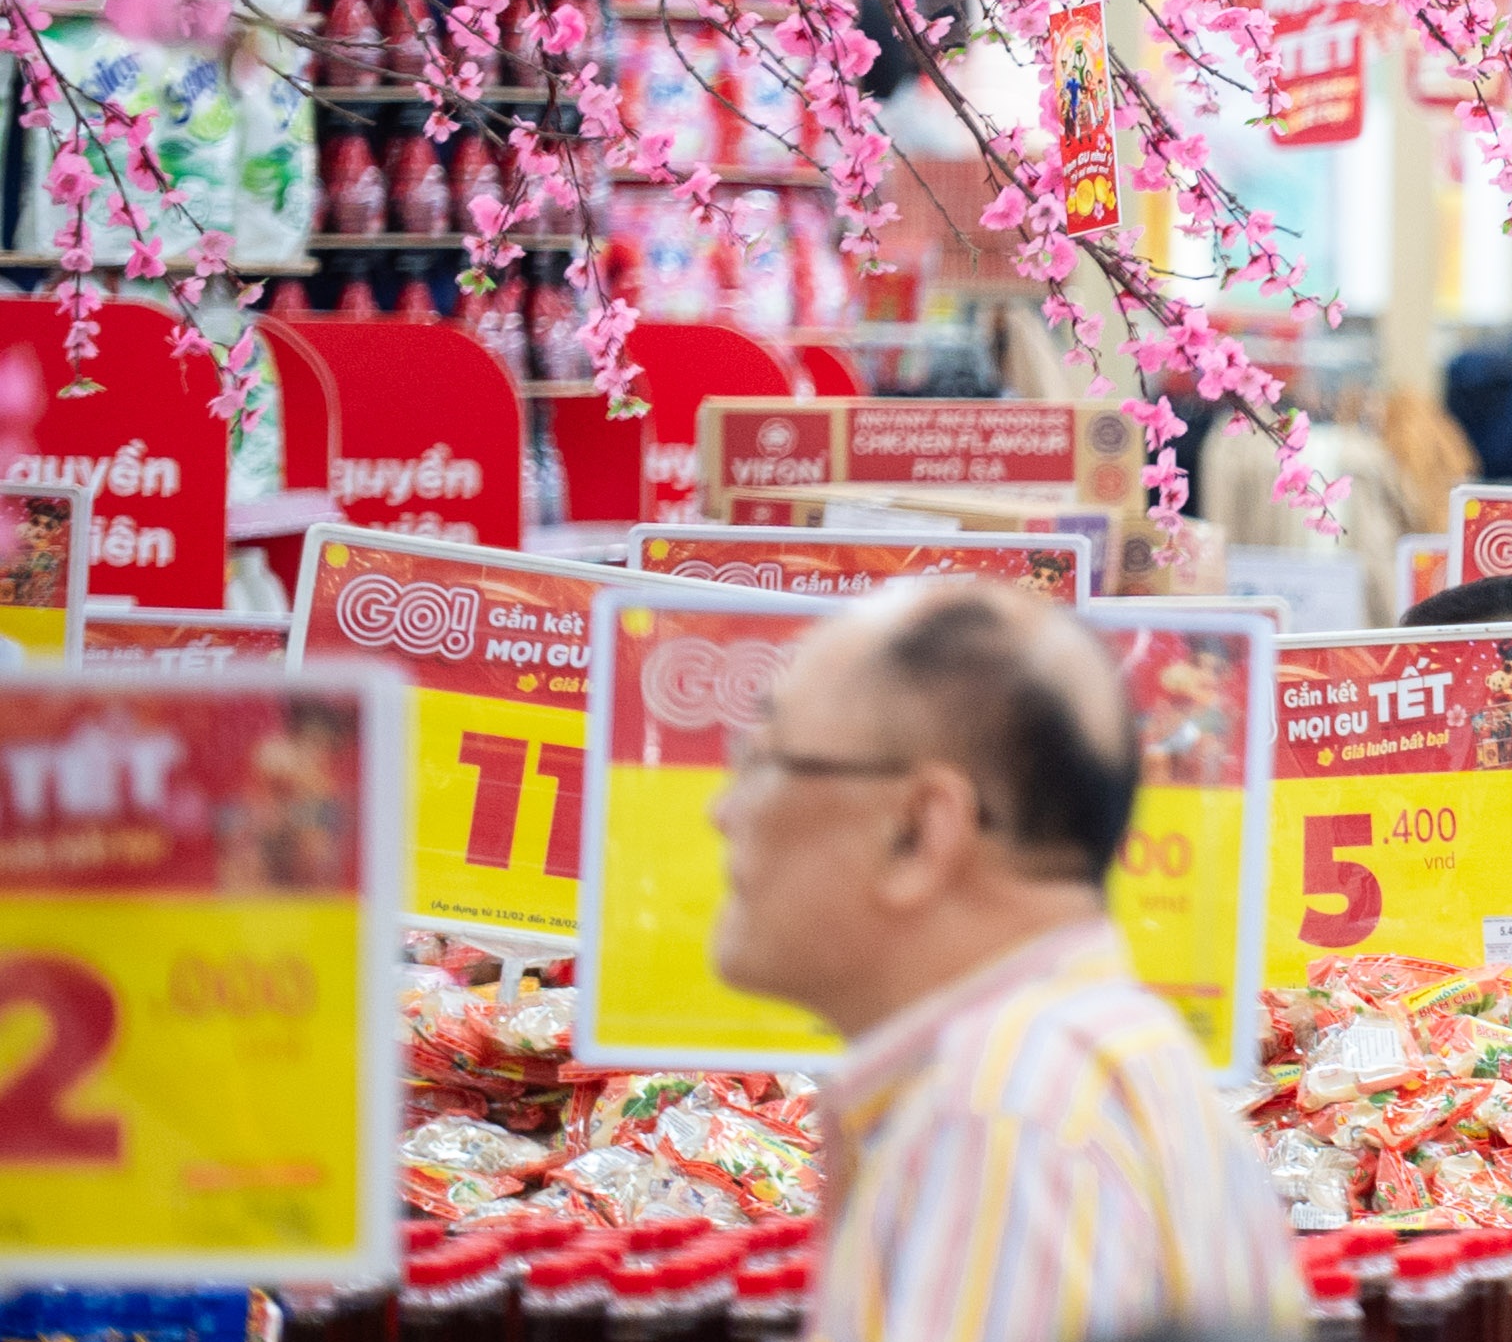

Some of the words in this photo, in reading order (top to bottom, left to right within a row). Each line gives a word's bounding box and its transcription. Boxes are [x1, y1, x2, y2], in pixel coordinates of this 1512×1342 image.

[853, 429, 954, 456] CHICKEN
[731, 457, 826, 486] VIFON
[88, 515, 176, 568] iên
[790, 568, 833, 594] Gắn
[837, 570, 873, 596] kết
[336, 573, 481, 660] GO!
[488, 602, 537, 632] Gắn
[543, 608, 585, 636] kết
[485, 638, 541, 668] MỌI
[547, 643, 592, 669] GU
[549, 671, 580, 694] Giá
[640, 635, 789, 733] GO
[1283, 681, 1323, 709] Gắn
[1326, 678, 1359, 704] kết
[1368, 657, 1454, 723] TẾT
[1288, 715, 1331, 746] MỌI
[1334, 710, 1369, 736] GU
[1341, 740, 1366, 762] Giá
[1366, 737, 1398, 758] luôn
[1399, 732, 1425, 751] bất
[1426, 729, 1450, 748] bại
[1382, 807, 1457, 846] .400
[1117, 829, 1193, 880] 00
[1424, 851, 1456, 871] vnd
[1297, 812, 1383, 949] 5
[496, 909, 525, 923] 11/02
[1453, 990, 1478, 1006] CHI
